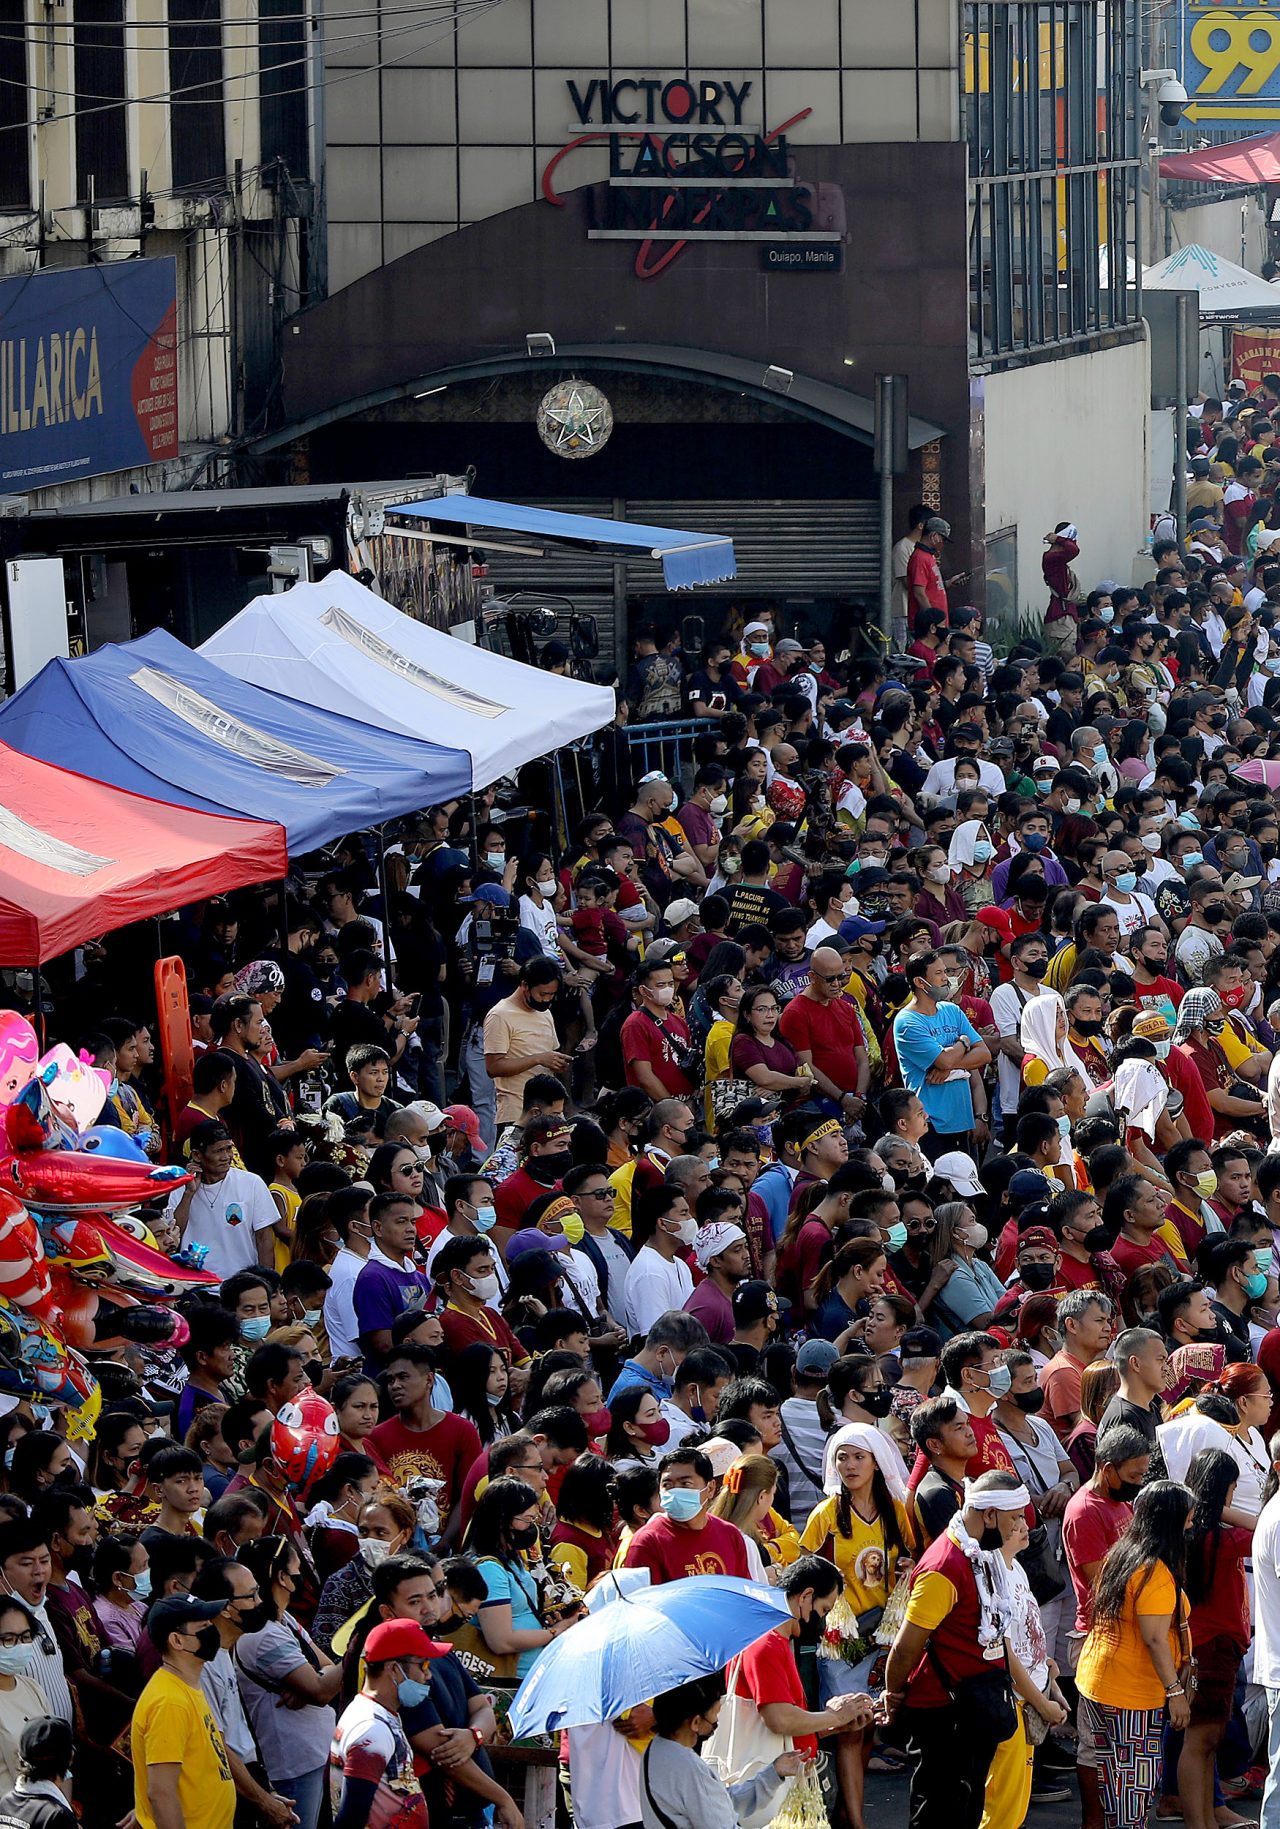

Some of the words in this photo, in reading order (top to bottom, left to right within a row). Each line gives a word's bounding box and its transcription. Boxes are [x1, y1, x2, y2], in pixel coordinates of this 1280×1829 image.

[566, 78, 752, 125] VICTORY
[609, 133, 789, 177] LACSON
[769, 251, 803, 264] Quiapo,
[805, 251, 834, 262] Manila
[813, 1121, 832, 1138] VIVA
